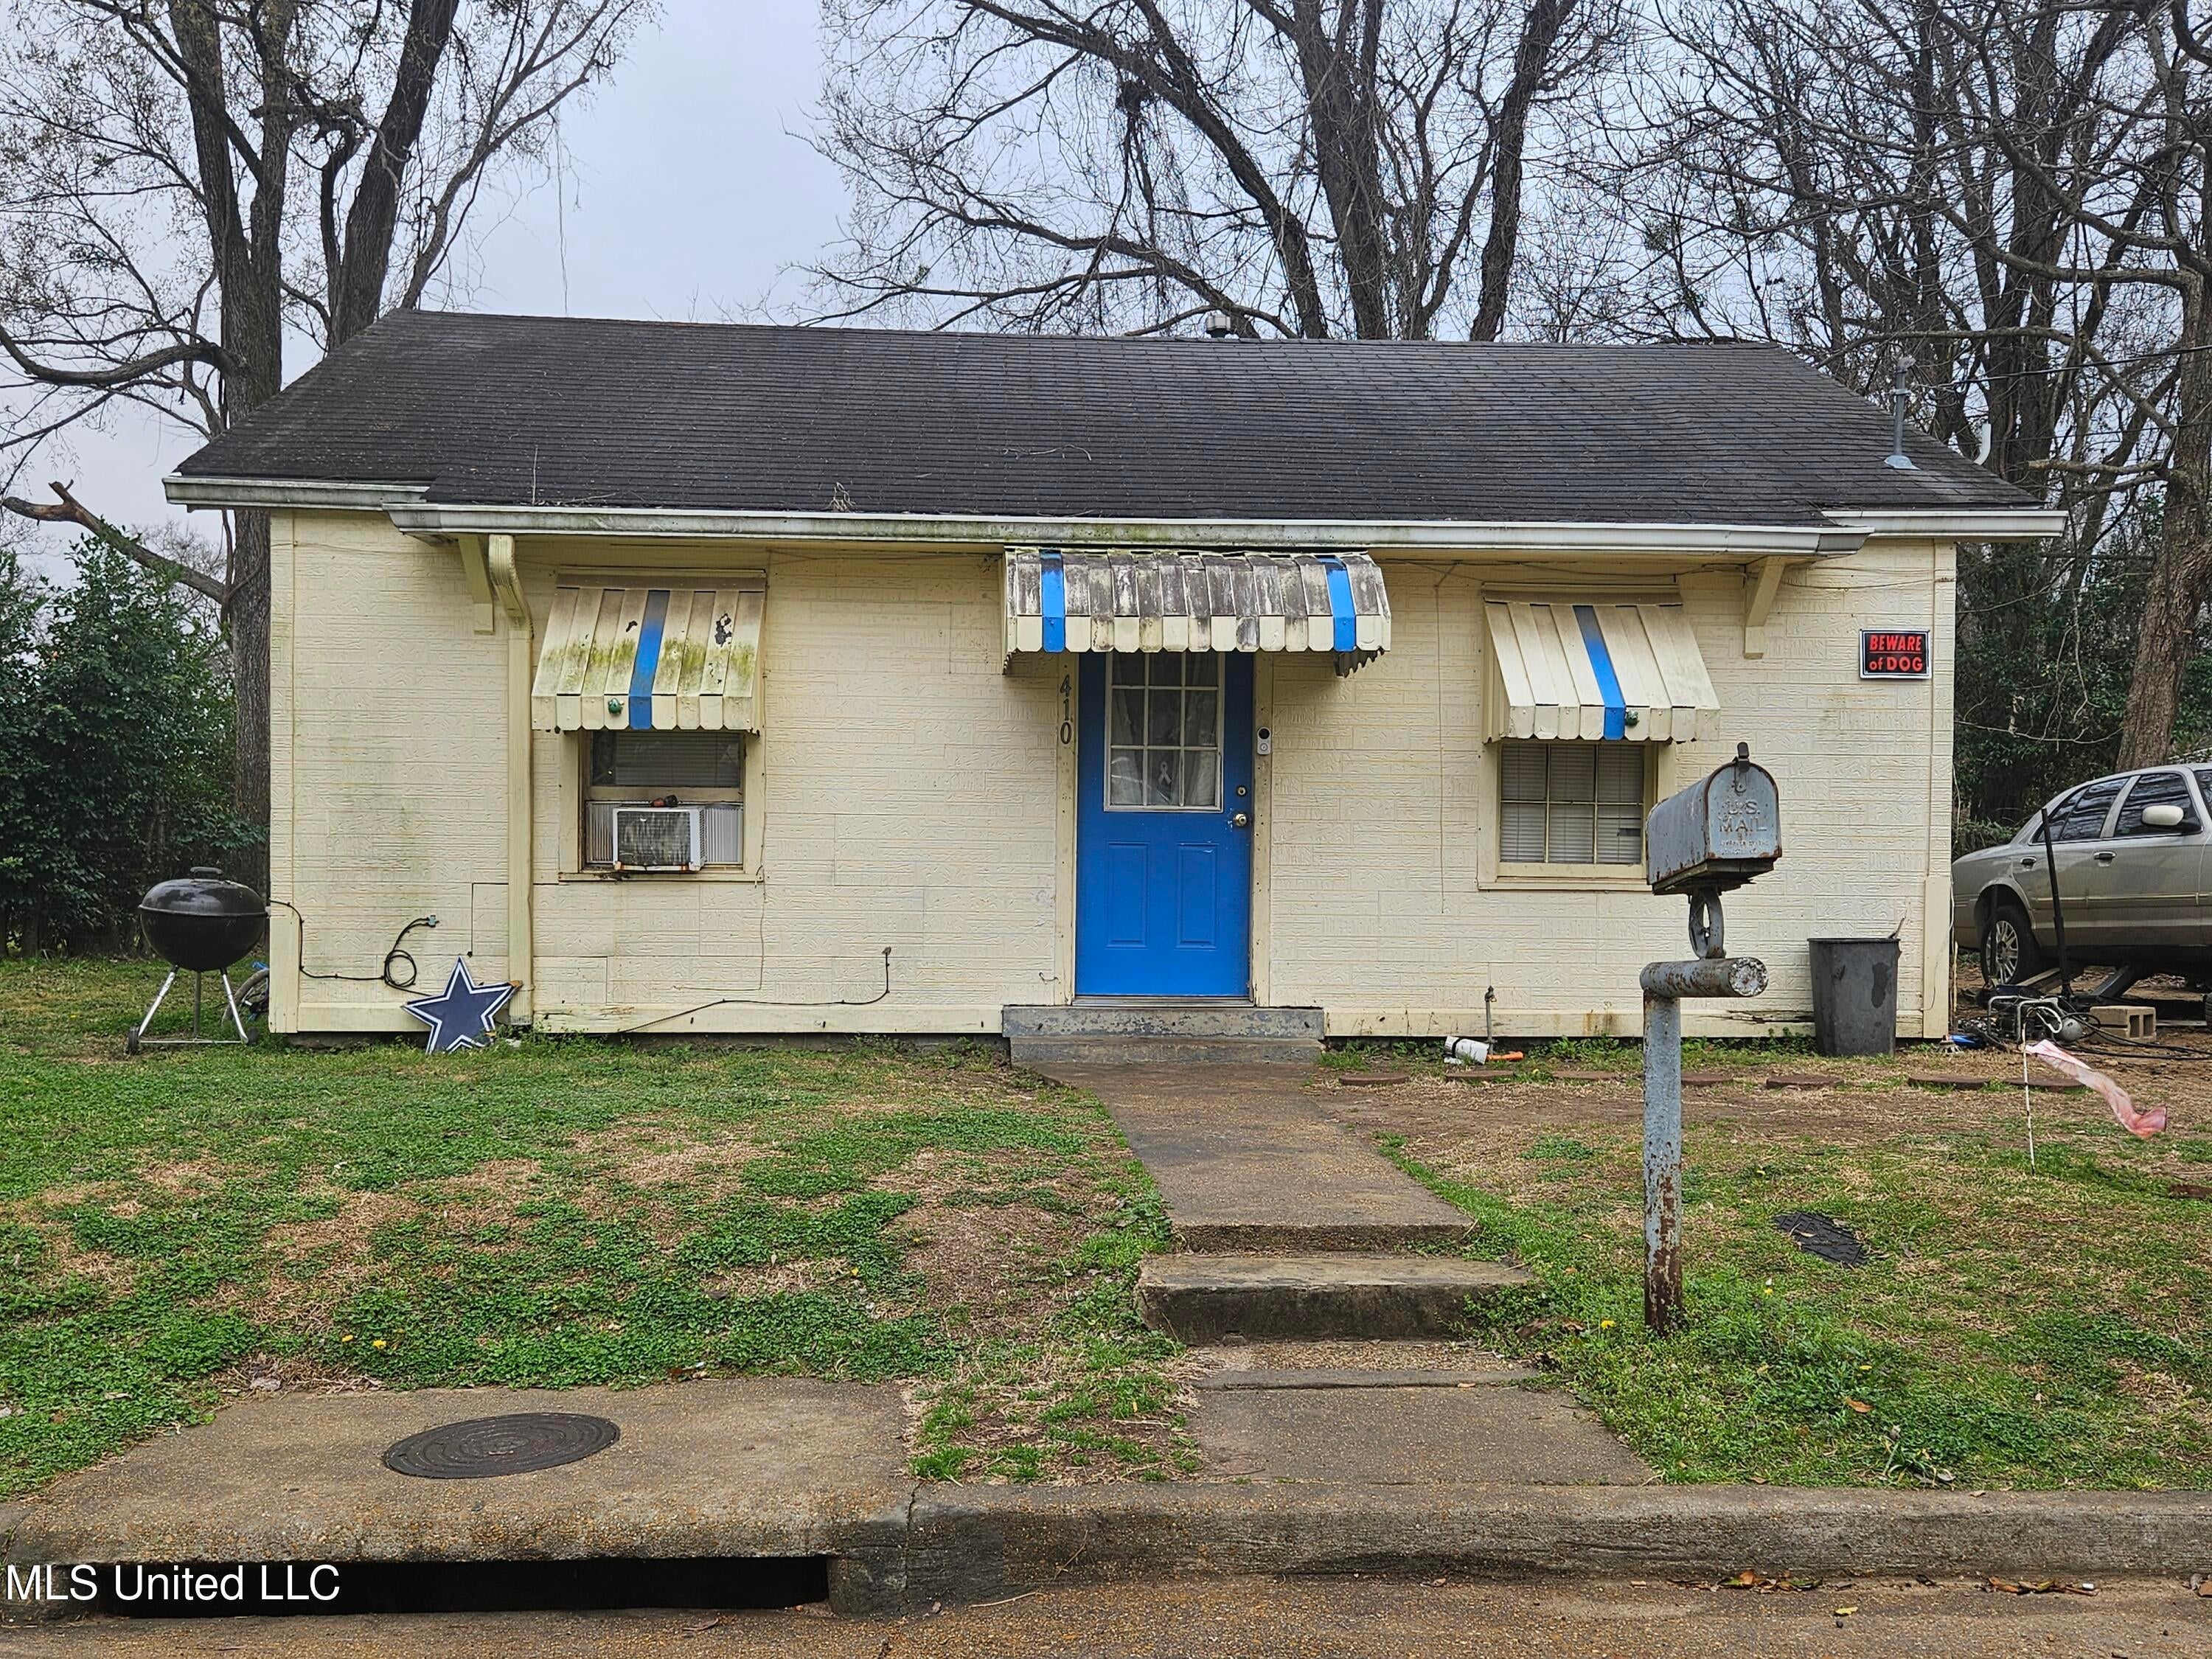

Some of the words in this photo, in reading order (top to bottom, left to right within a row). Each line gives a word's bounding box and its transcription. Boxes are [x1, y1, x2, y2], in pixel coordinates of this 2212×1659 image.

[1869, 635, 1922, 650] BEWARE
[1869, 657, 1883, 670] of
[1886, 656, 1923, 672] DOG
[1060, 674, 1072, 745] 410
[1717, 816, 1767, 832] MAIL
